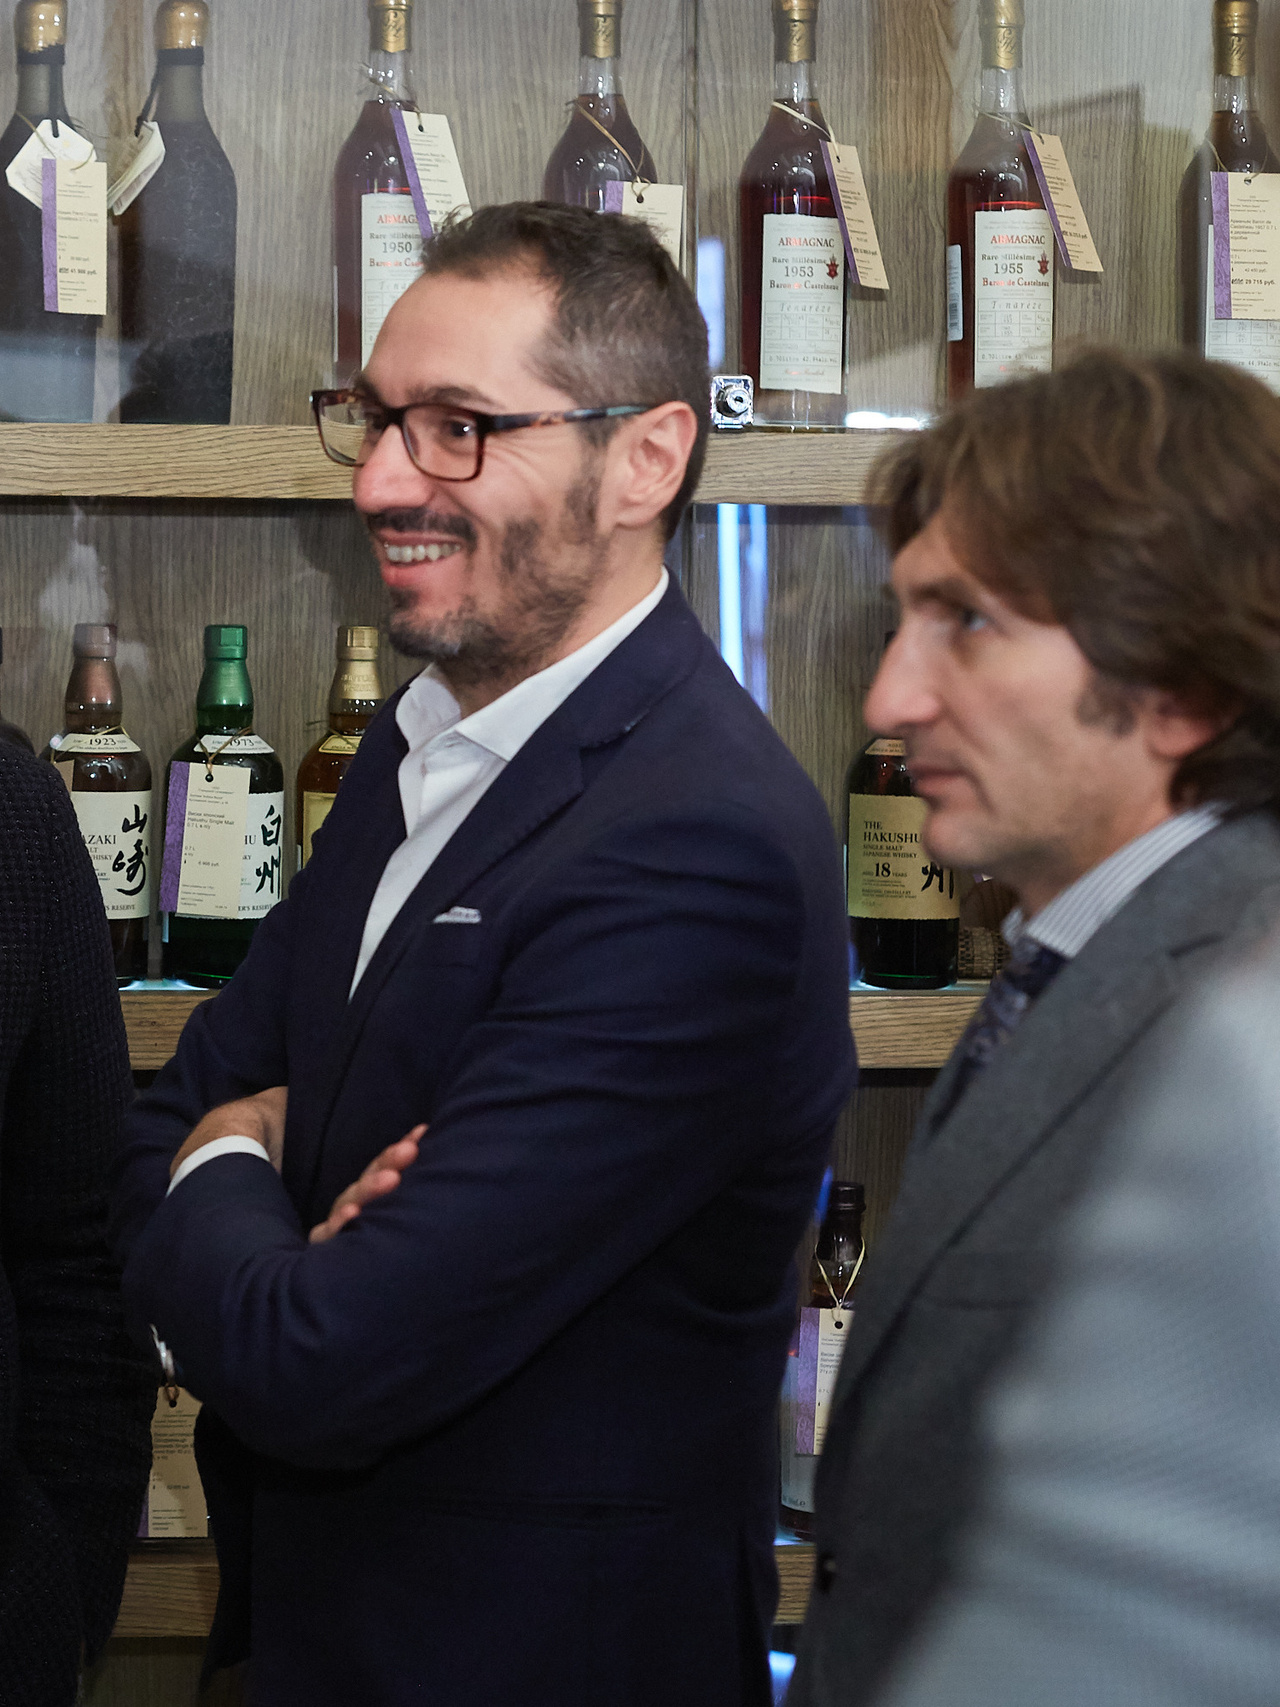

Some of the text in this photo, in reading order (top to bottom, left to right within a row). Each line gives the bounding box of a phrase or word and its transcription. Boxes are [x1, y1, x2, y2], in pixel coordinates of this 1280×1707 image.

[778, 237, 835, 248] ARMAGNAC
[990, 235, 1046, 245] ARMAGNAC
[382, 242, 413, 253] 1950
[785, 266, 814, 278] 1953
[994, 263, 1023, 274] 1955
[769, 280, 792, 289] Baron
[982, 277, 1005, 287] Baron
[89, 737, 117, 746] 1923
[864, 820, 883, 830] THE
[863, 831, 923, 844] HAKUSHU
[875, 862, 891, 878] 18
